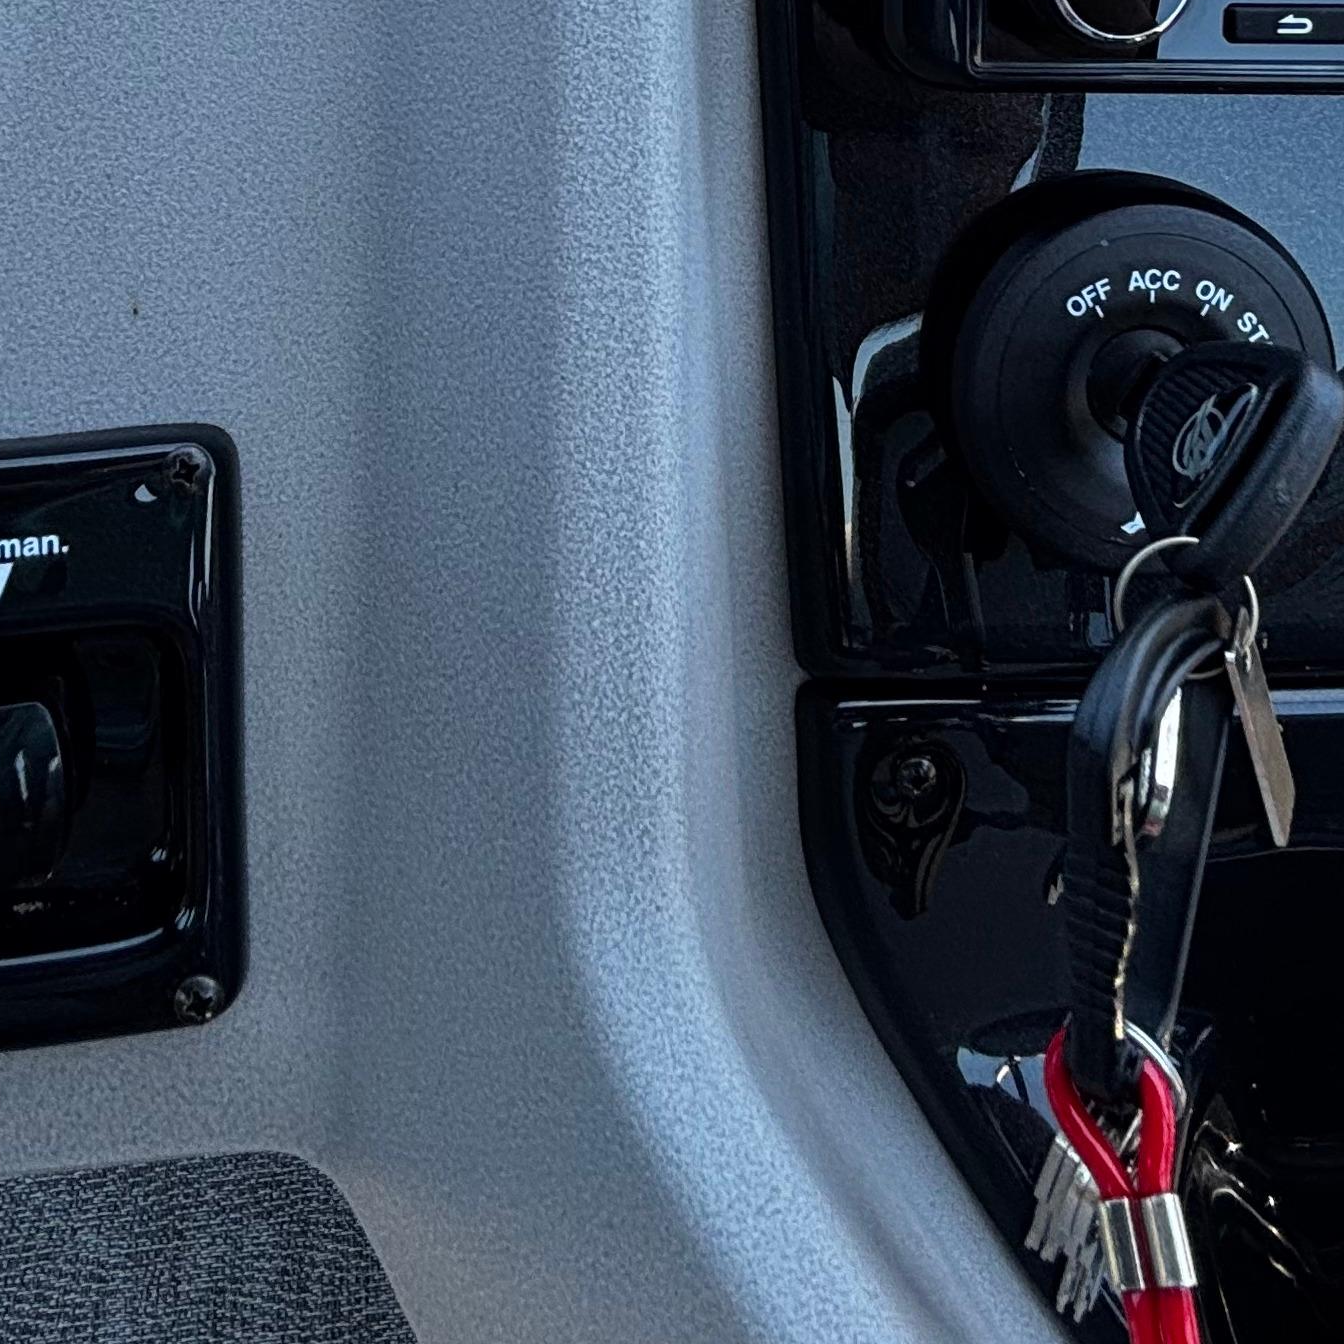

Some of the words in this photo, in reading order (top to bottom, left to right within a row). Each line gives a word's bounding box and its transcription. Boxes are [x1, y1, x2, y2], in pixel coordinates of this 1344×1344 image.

[1066, 278, 1111, 317] OFF
[1128, 268, 1181, 292] ACC
[1195, 279, 1234, 312] ON
